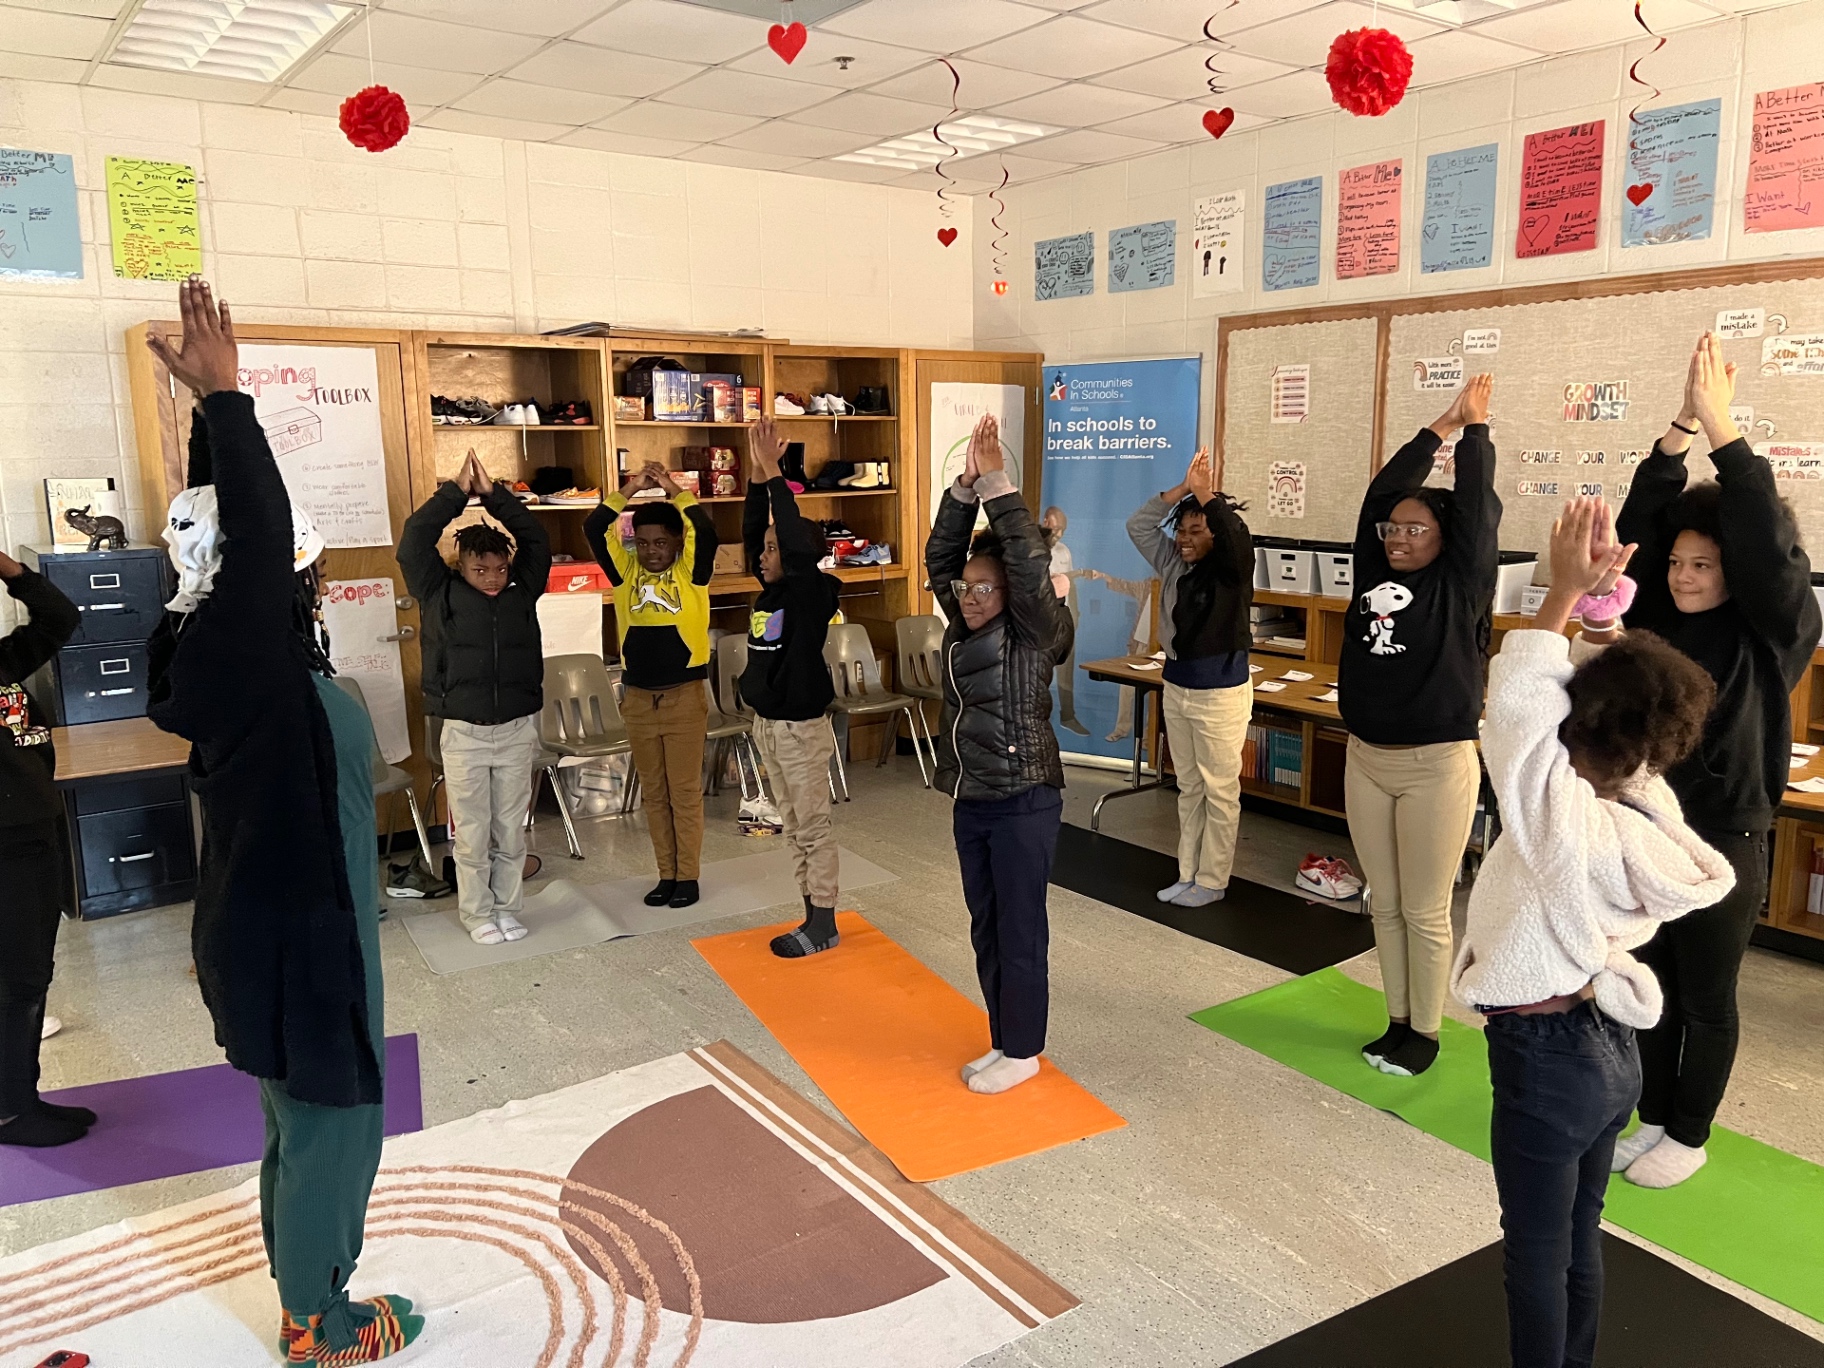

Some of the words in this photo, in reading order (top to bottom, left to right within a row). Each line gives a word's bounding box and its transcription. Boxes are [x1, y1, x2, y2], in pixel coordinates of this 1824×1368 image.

[1755, 94, 1763, 109] A
[1766, 88, 1813, 108] Better
[1529, 134, 1537, 150] A
[121, 172, 131, 180] A
[1343, 171, 1351, 183] A
[1730, 312, 1748, 320] made
[1721, 321, 1757, 331] mistake
[736, 374, 742, 384] 6
[1429, 370, 1461, 380] PRACTICE
[237, 364, 316, 401] oping
[1070, 378, 1133, 390] Communities
[308, 387, 372, 405] TOOLBOX
[1070, 391, 1079, 400] In
[1082, 389, 1119, 400] Schools
[1564, 381, 1627, 402] GROWTH
[1564, 402, 1629, 421] MINDSET
[1048, 418, 1061, 433] In
[1066, 416, 1134, 433] schools
[1138, 416, 1157, 430] to
[273, 430, 316, 452] TOOLBOX
[1047, 435, 1094, 451] break
[1098, 434, 1172, 450] barriers.
[1520, 451, 1560, 464] CHANGE
[1577, 452, 1604, 464] YOUR
[1519, 483, 1558, 495] CHANGE
[1575, 483, 1602, 496] YOUR
[572, 576, 588, 584] NIKE
